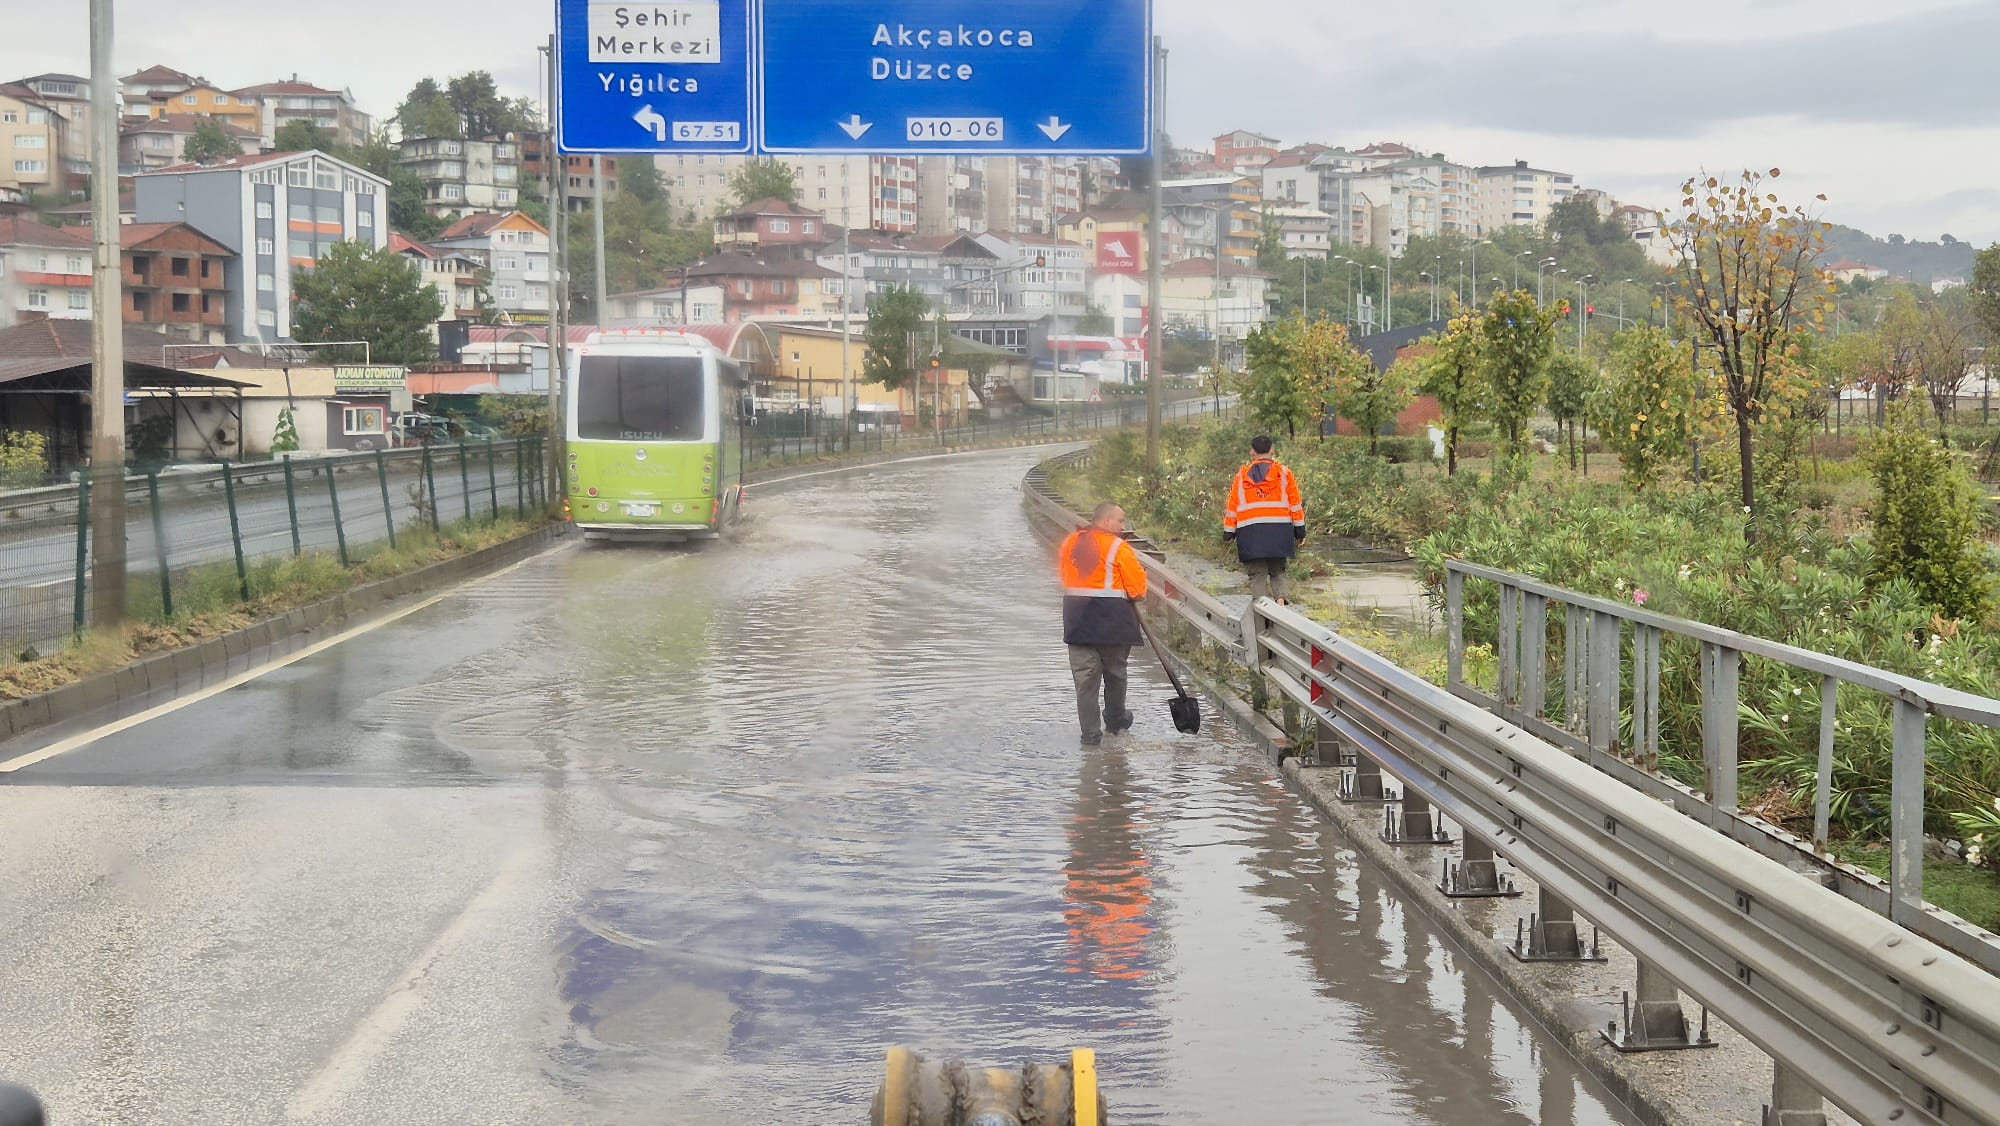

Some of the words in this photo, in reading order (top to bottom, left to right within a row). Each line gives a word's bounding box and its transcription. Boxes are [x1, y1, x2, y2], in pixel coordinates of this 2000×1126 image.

[615, 8, 692, 29] Şehir
[597, 36, 711, 55] Merkezi
[872, 23, 1034, 49] Akçakoca
[871, 57, 974, 80] Düzce
[598, 72, 699, 97] Yığılca
[910, 121, 998, 137] 010-06
[620, 431, 663, 440] ISUZU
